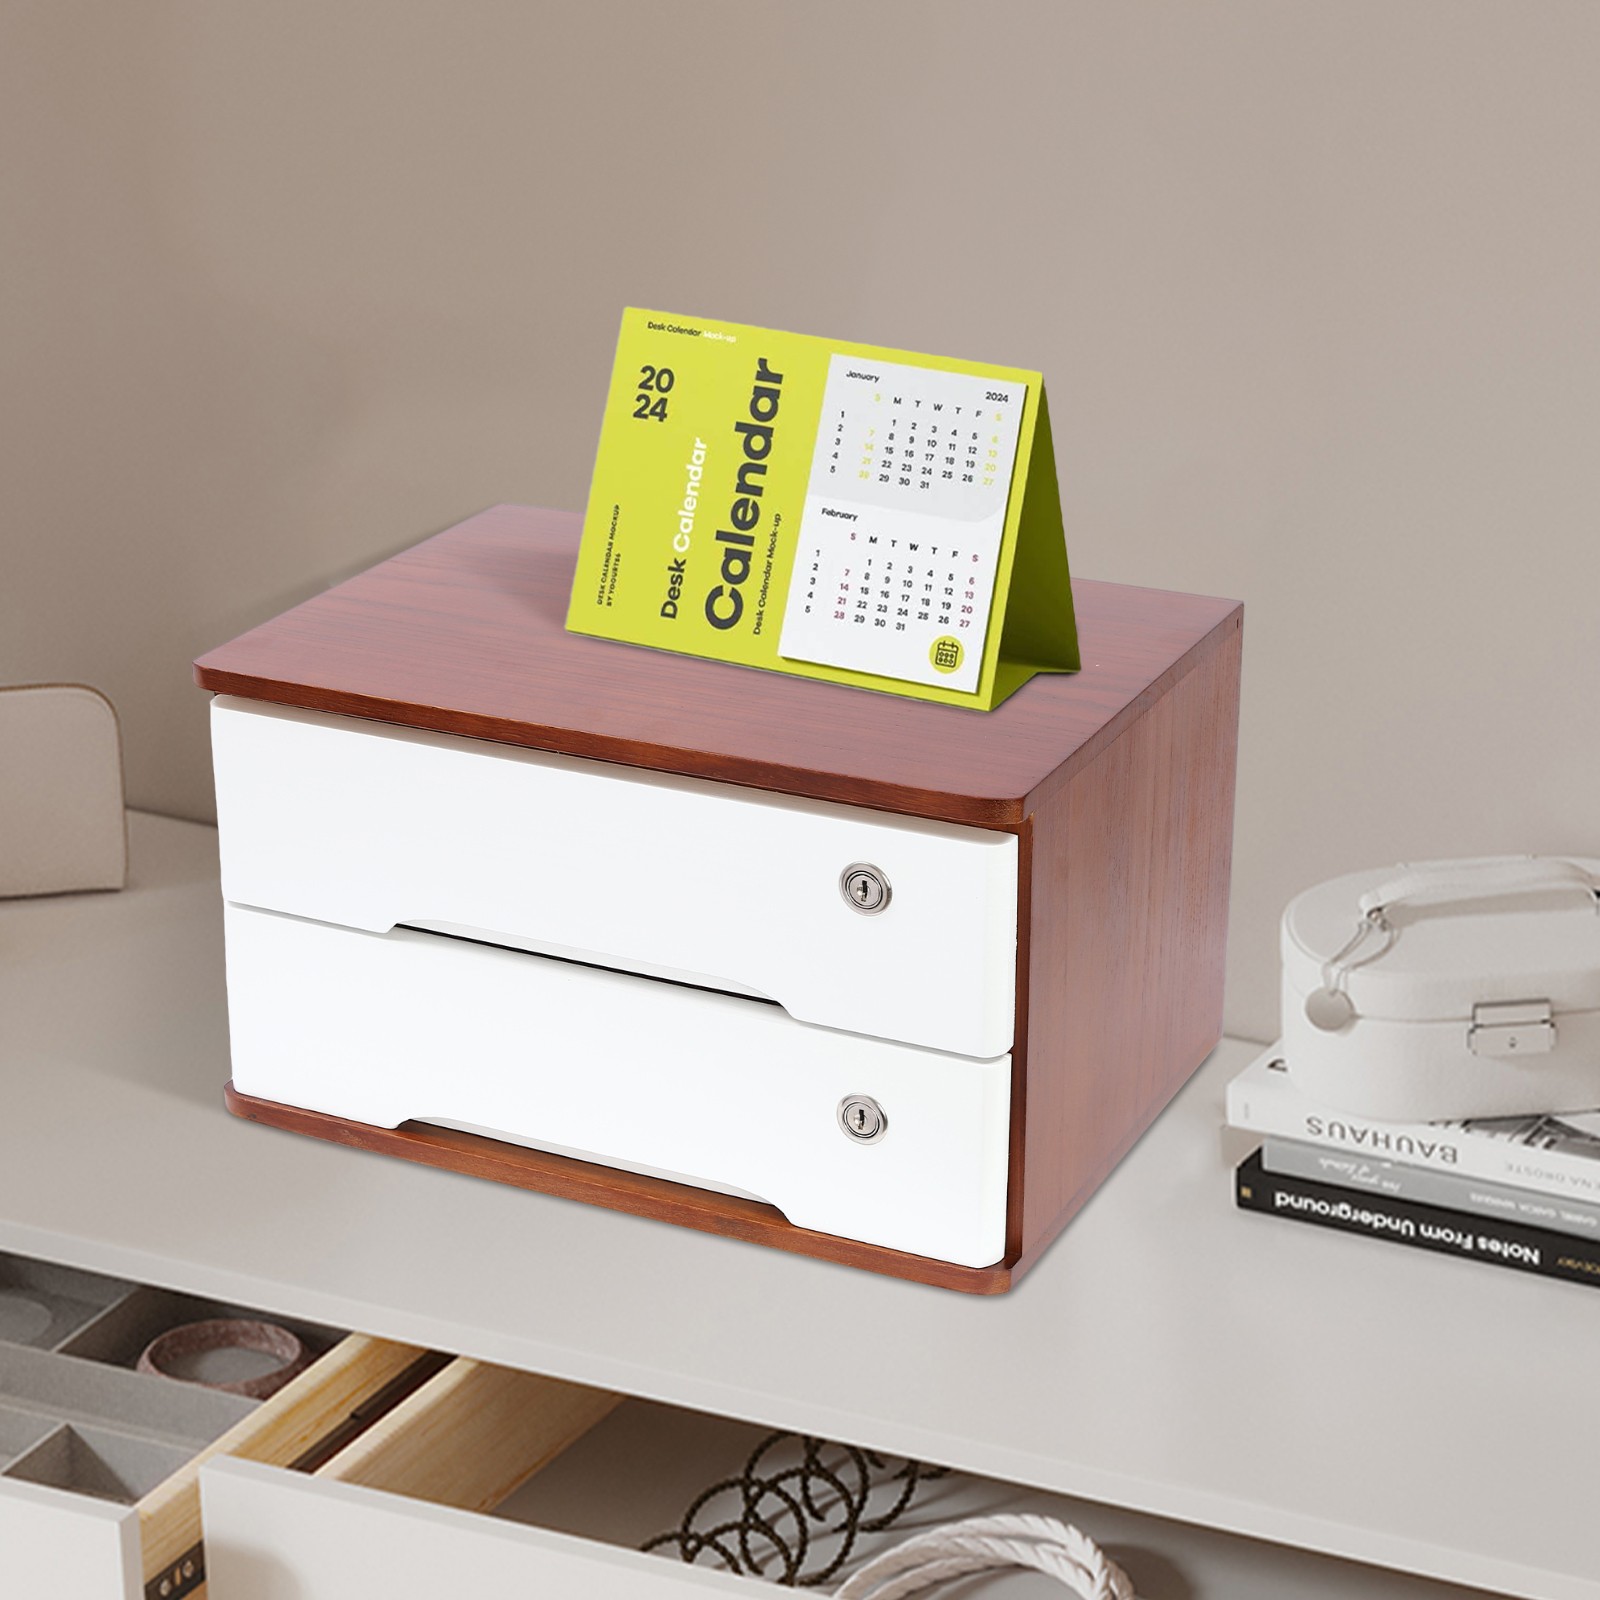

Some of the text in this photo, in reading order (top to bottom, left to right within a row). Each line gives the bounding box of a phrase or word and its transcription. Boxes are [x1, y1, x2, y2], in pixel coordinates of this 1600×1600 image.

[647, 321, 666, 331] Desk
[667, 324, 702, 336] Calendar
[638, 365, 675, 393] 20
[846, 370, 1009, 403] January 2024
[633, 393, 669, 422] 24
[893, 396, 902, 405] M
[933, 403, 943, 412] W
[955, 406, 962, 415] T
[975, 410, 982, 418] F
[837, 423, 844, 432] 2
[888, 432, 895, 441] 8
[908, 435, 915, 445] 9
[927, 439, 938, 449] 10
[948, 442, 956, 451] 11
[968, 446, 978, 455] 12
[911, 422, 918, 431] 2
[931, 425, 938, 434] 3
[950, 429, 958, 437] 4
[971, 432, 978, 441] 5
[832, 451, 839, 460] 4
[881, 459, 892, 469] 22
[901, 463, 912, 473] 23
[921, 466, 932, 476] 24
[941, 470, 953, 480] 25
[962, 473, 973, 483] 26
[834, 437, 841, 446] 3
[884, 446, 894, 455] 15
[904, 449, 915, 458] 16
[925, 453, 935, 462] 17
[945, 456, 955, 466] 18
[965, 459, 976, 469] 19
[829, 465, 836, 474] 5
[878, 473, 890, 483] 29
[898, 476, 911, 487] 30
[919, 480, 930, 489] 31
[704, 357, 784, 631] Calendar
[661, 437, 707, 619] Desk Calendar
[821, 507, 858, 522] February
[597, 504, 620, 606] DESK CALENDAR MOCKUP
[850, 532, 979, 563] S M T W T F S
[752, 513, 782, 636] Desk Calendar Mock-up
[812, 562, 819, 572] 2
[863, 572, 871, 581] 8
[884, 575, 891, 585] 9
[902, 579, 913, 589] 10
[924, 583, 933, 592] 11
[944, 587, 954, 596] 12
[964, 590, 975, 600] 13
[886, 561, 893, 571] 2
[907, 565, 914, 574] 3
[927, 569, 934, 578] 4
[947, 573, 954, 582] 5
[968, 576, 975, 586] 6
[606, 594, 613, 607] BY
[807, 591, 971, 628] 4 21 22 23 24 25 26 27
[809, 576, 973, 615] 3 14 15 16 17 18 19 20
[804, 605, 906, 631] 5 28 29 30 31
[1306, 1116, 1458, 1163] BAUHAUS
[1275, 1192, 1541, 1265] Notes From Underground
